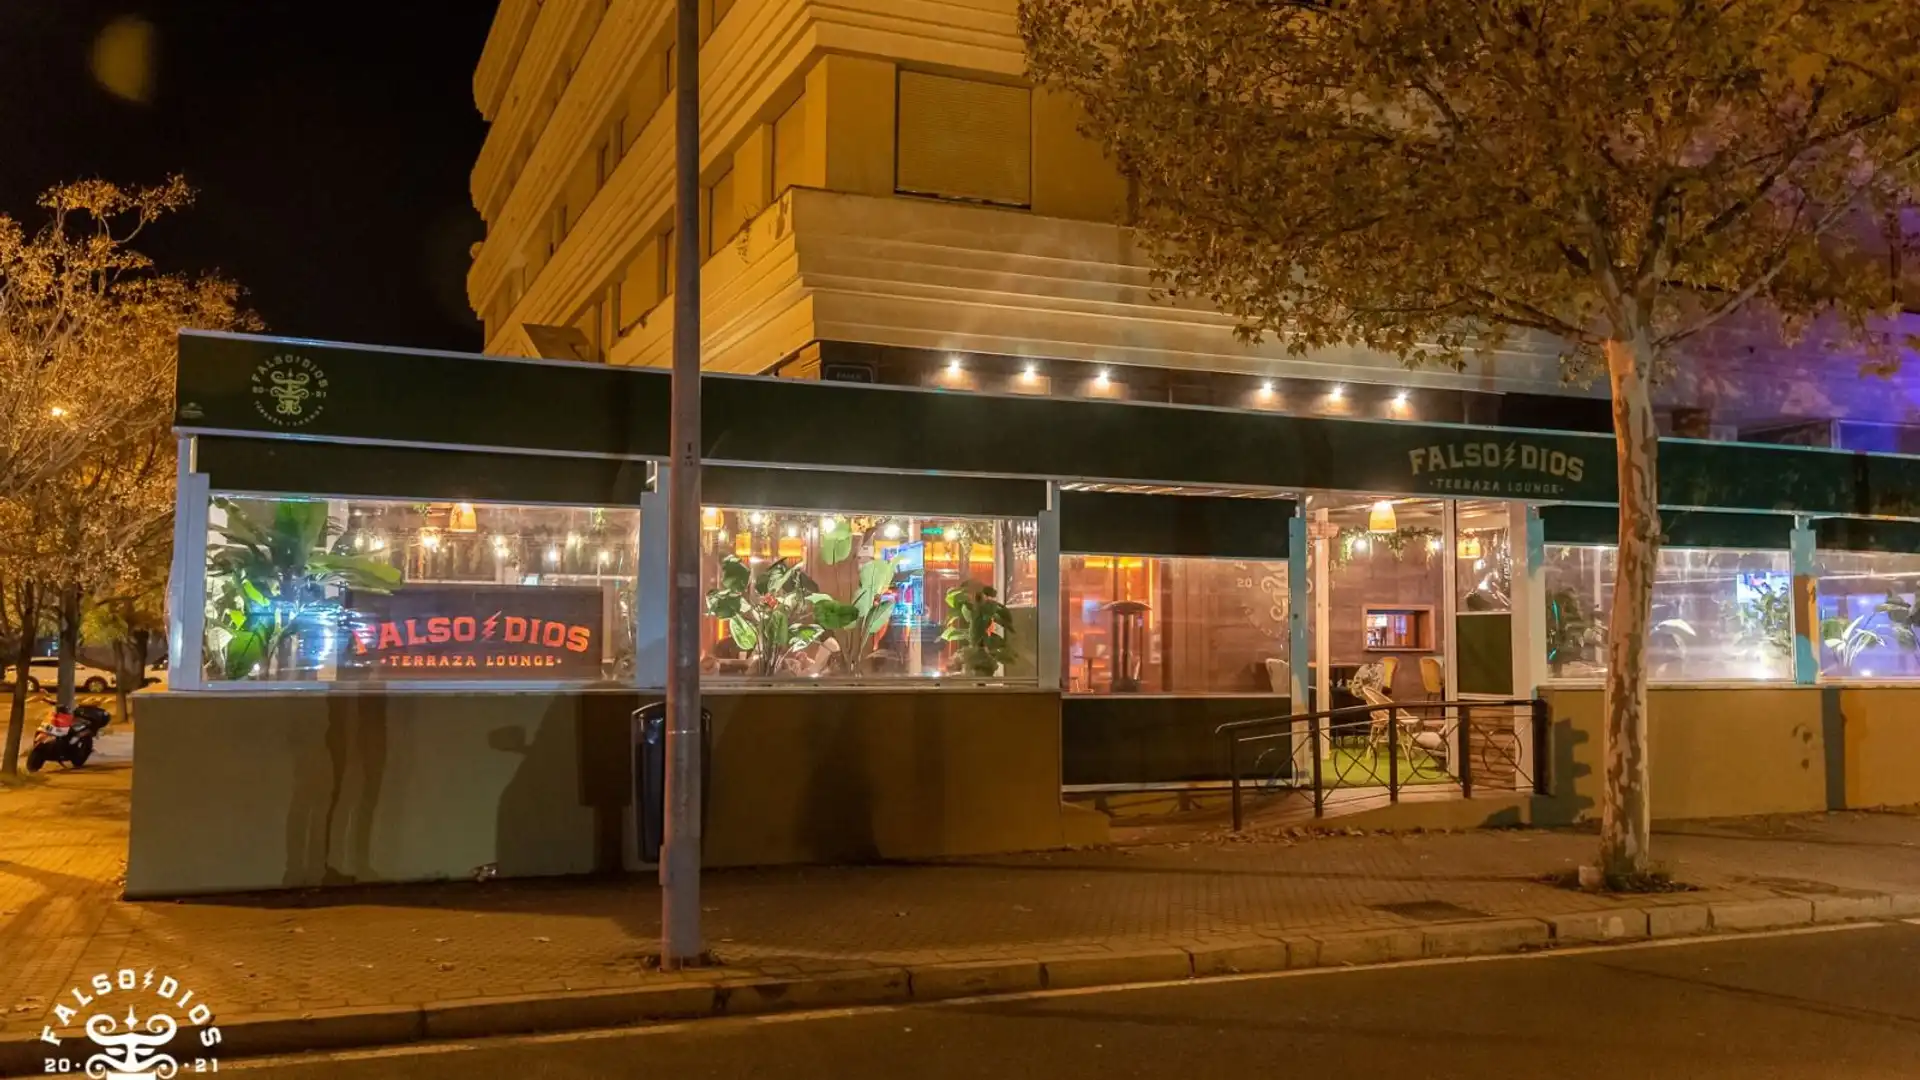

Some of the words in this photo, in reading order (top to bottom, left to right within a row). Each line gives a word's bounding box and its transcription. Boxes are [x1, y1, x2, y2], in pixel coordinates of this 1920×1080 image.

[1409, 443, 1500, 475] FALSO
[1520, 445, 1585, 482] DIOS
[352, 616, 476, 655] FALSO
[504, 616, 591, 652] DIOS
[390, 655, 476, 667] TERRAZA
[487, 655, 555, 667] LOUNGE
